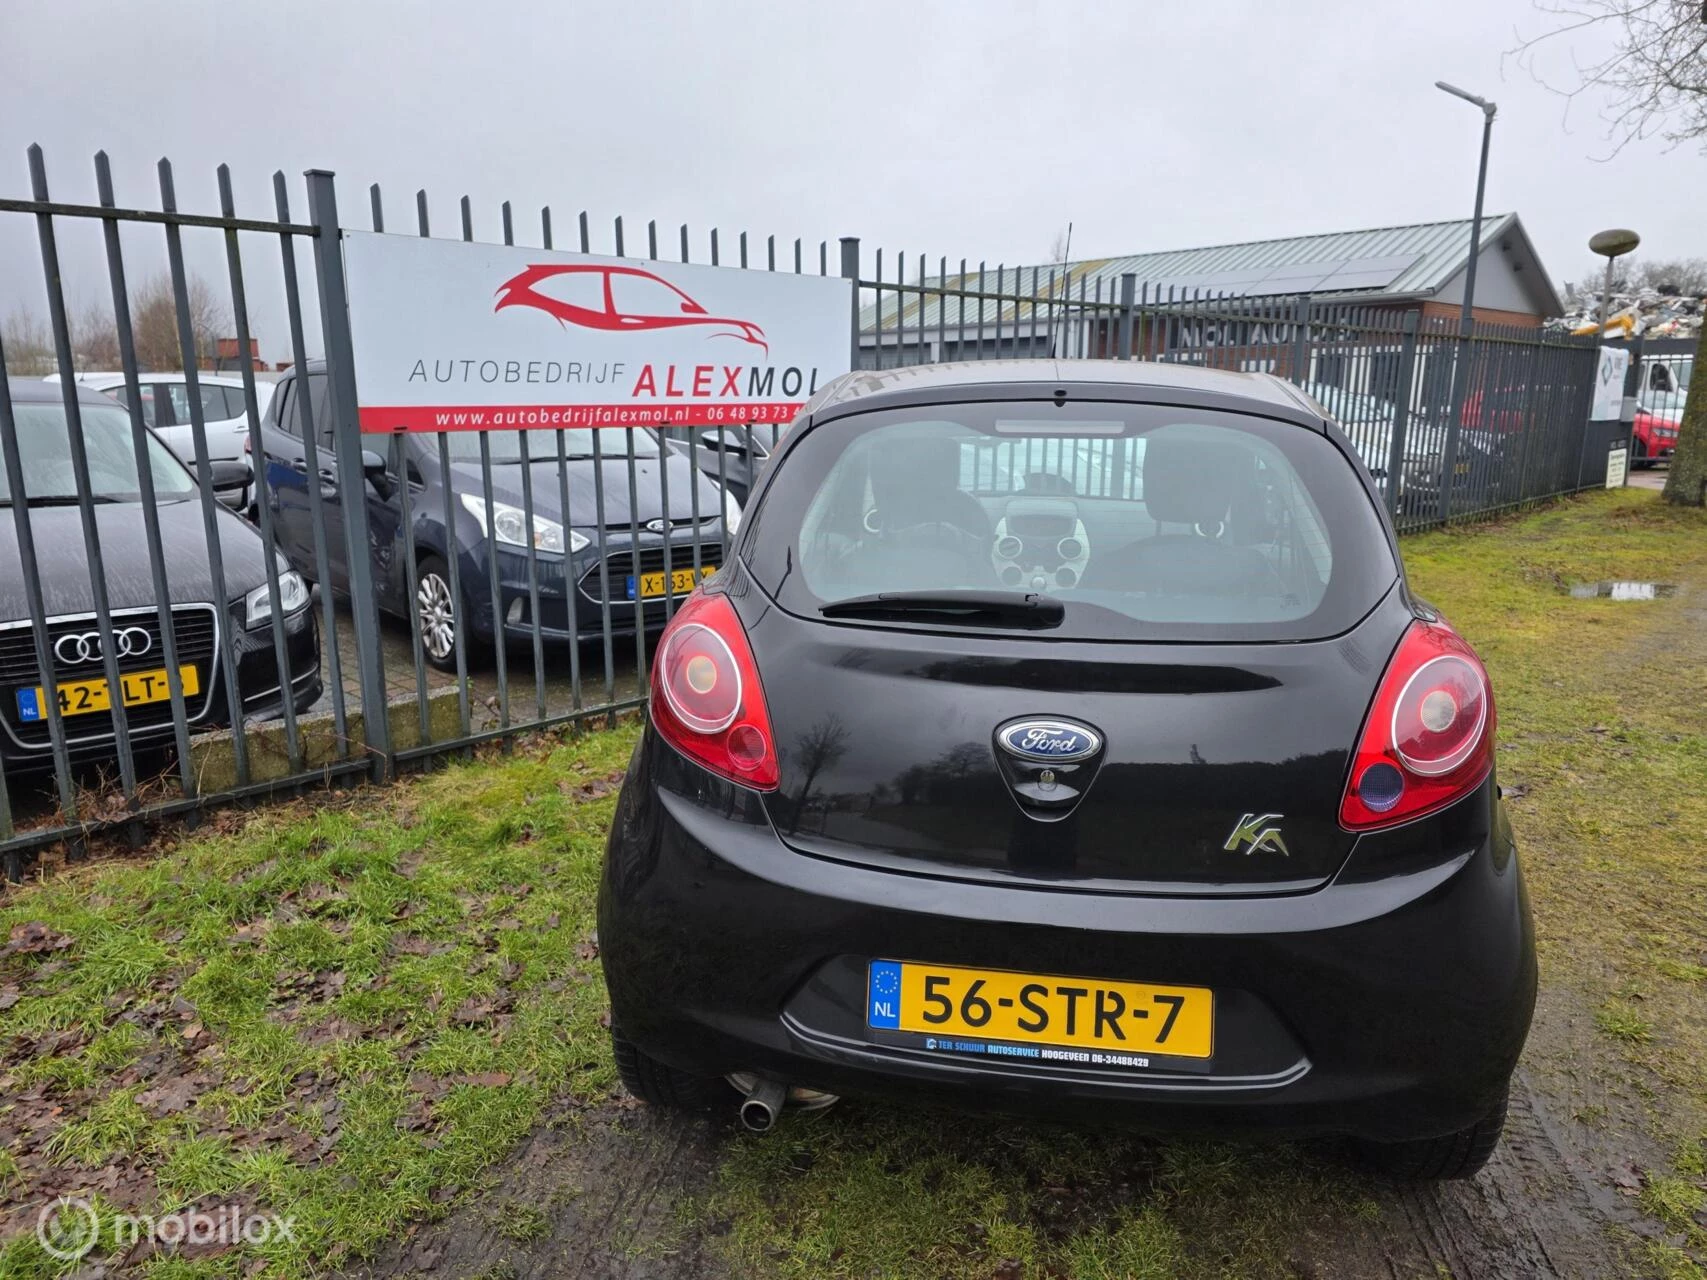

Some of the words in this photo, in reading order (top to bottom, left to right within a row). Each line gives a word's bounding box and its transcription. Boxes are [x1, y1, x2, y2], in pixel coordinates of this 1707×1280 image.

[408, 359, 625, 384] AUTOBEDRIJF
[436, 405, 689, 426] www.autobedrijfalexmol.nl
[707, 407, 724, 420] 06
[730, 406, 746, 420] 48
[752, 406, 767, 420] 93
[773, 406, 788, 419] 73
[22, 706, 37, 716] NL
[1022, 728, 1077, 752] Ford
[874, 1001, 896, 1018] NL
[922, 974, 1186, 1043] 56-STR-7
[938, 1040, 953, 1050] TER
[955, 1042, 986, 1052] SCHUUR
[987, 1044, 1040, 1058] AUTOSERVICE
[1041, 1049, 1090, 1062] HOOGEVEEN
